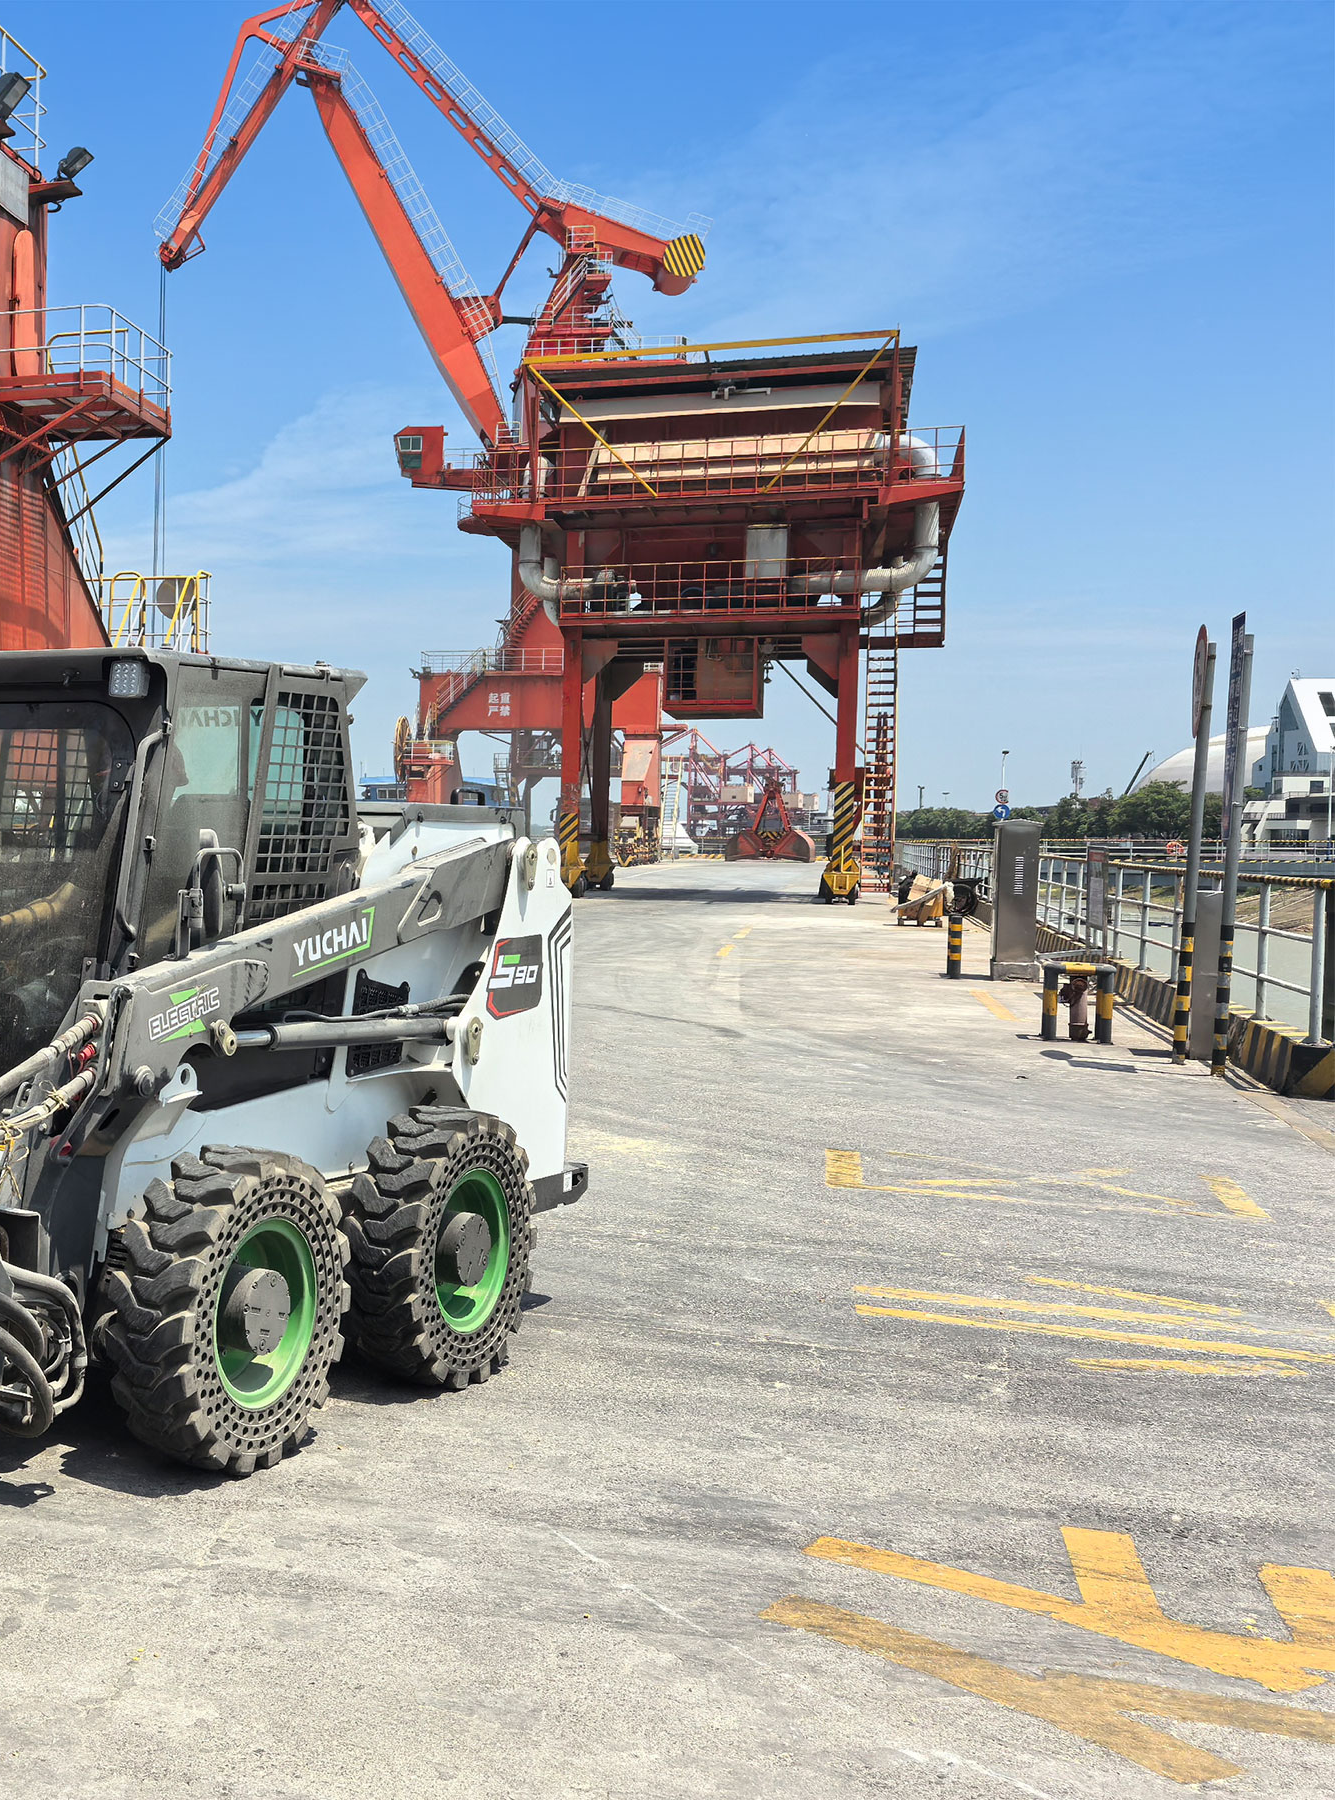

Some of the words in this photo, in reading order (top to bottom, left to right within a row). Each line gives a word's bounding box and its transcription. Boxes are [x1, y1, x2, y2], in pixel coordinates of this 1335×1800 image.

[488, 692, 511, 704] 起重
[488, 704, 511, 717] 严禁
[293, 917, 368, 967] YUCHAI
[149, 987, 220, 1041] ELECTRIC
